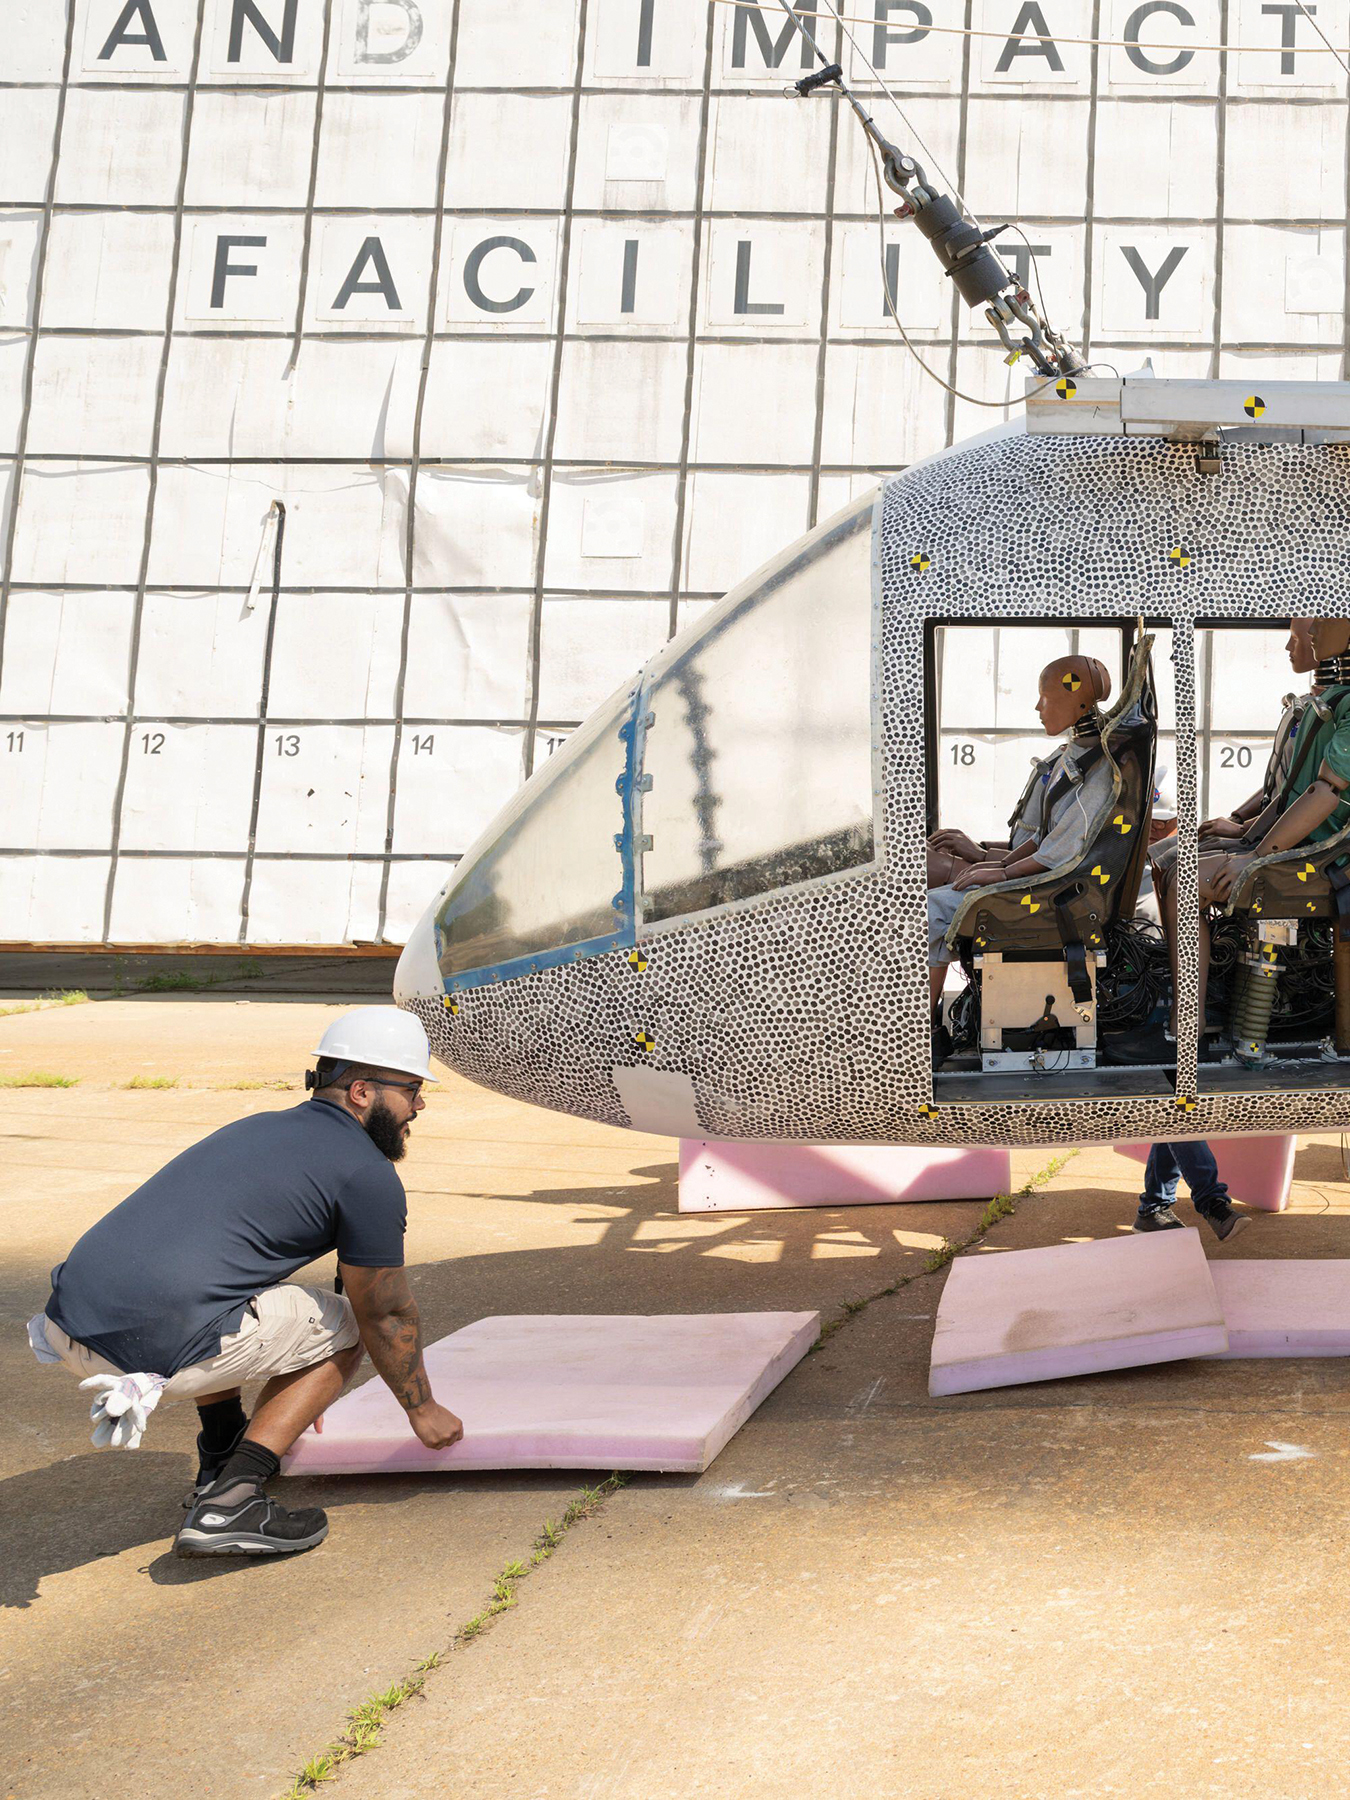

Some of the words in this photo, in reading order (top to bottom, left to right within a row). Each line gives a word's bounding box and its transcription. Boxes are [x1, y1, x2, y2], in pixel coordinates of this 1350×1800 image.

[97, 0, 423, 64] AND
[636, 0, 1317, 75] IMPACT
[210, 235, 1189, 321] FACILITY
[6, 731, 24, 753] 11
[141, 733, 166, 755] 12
[275, 735, 301, 757] 13
[412, 734, 435, 756] 14
[546, 737, 567, 756] 1
[950, 744, 976, 766] 18
[1220, 746, 1253, 769] 20
